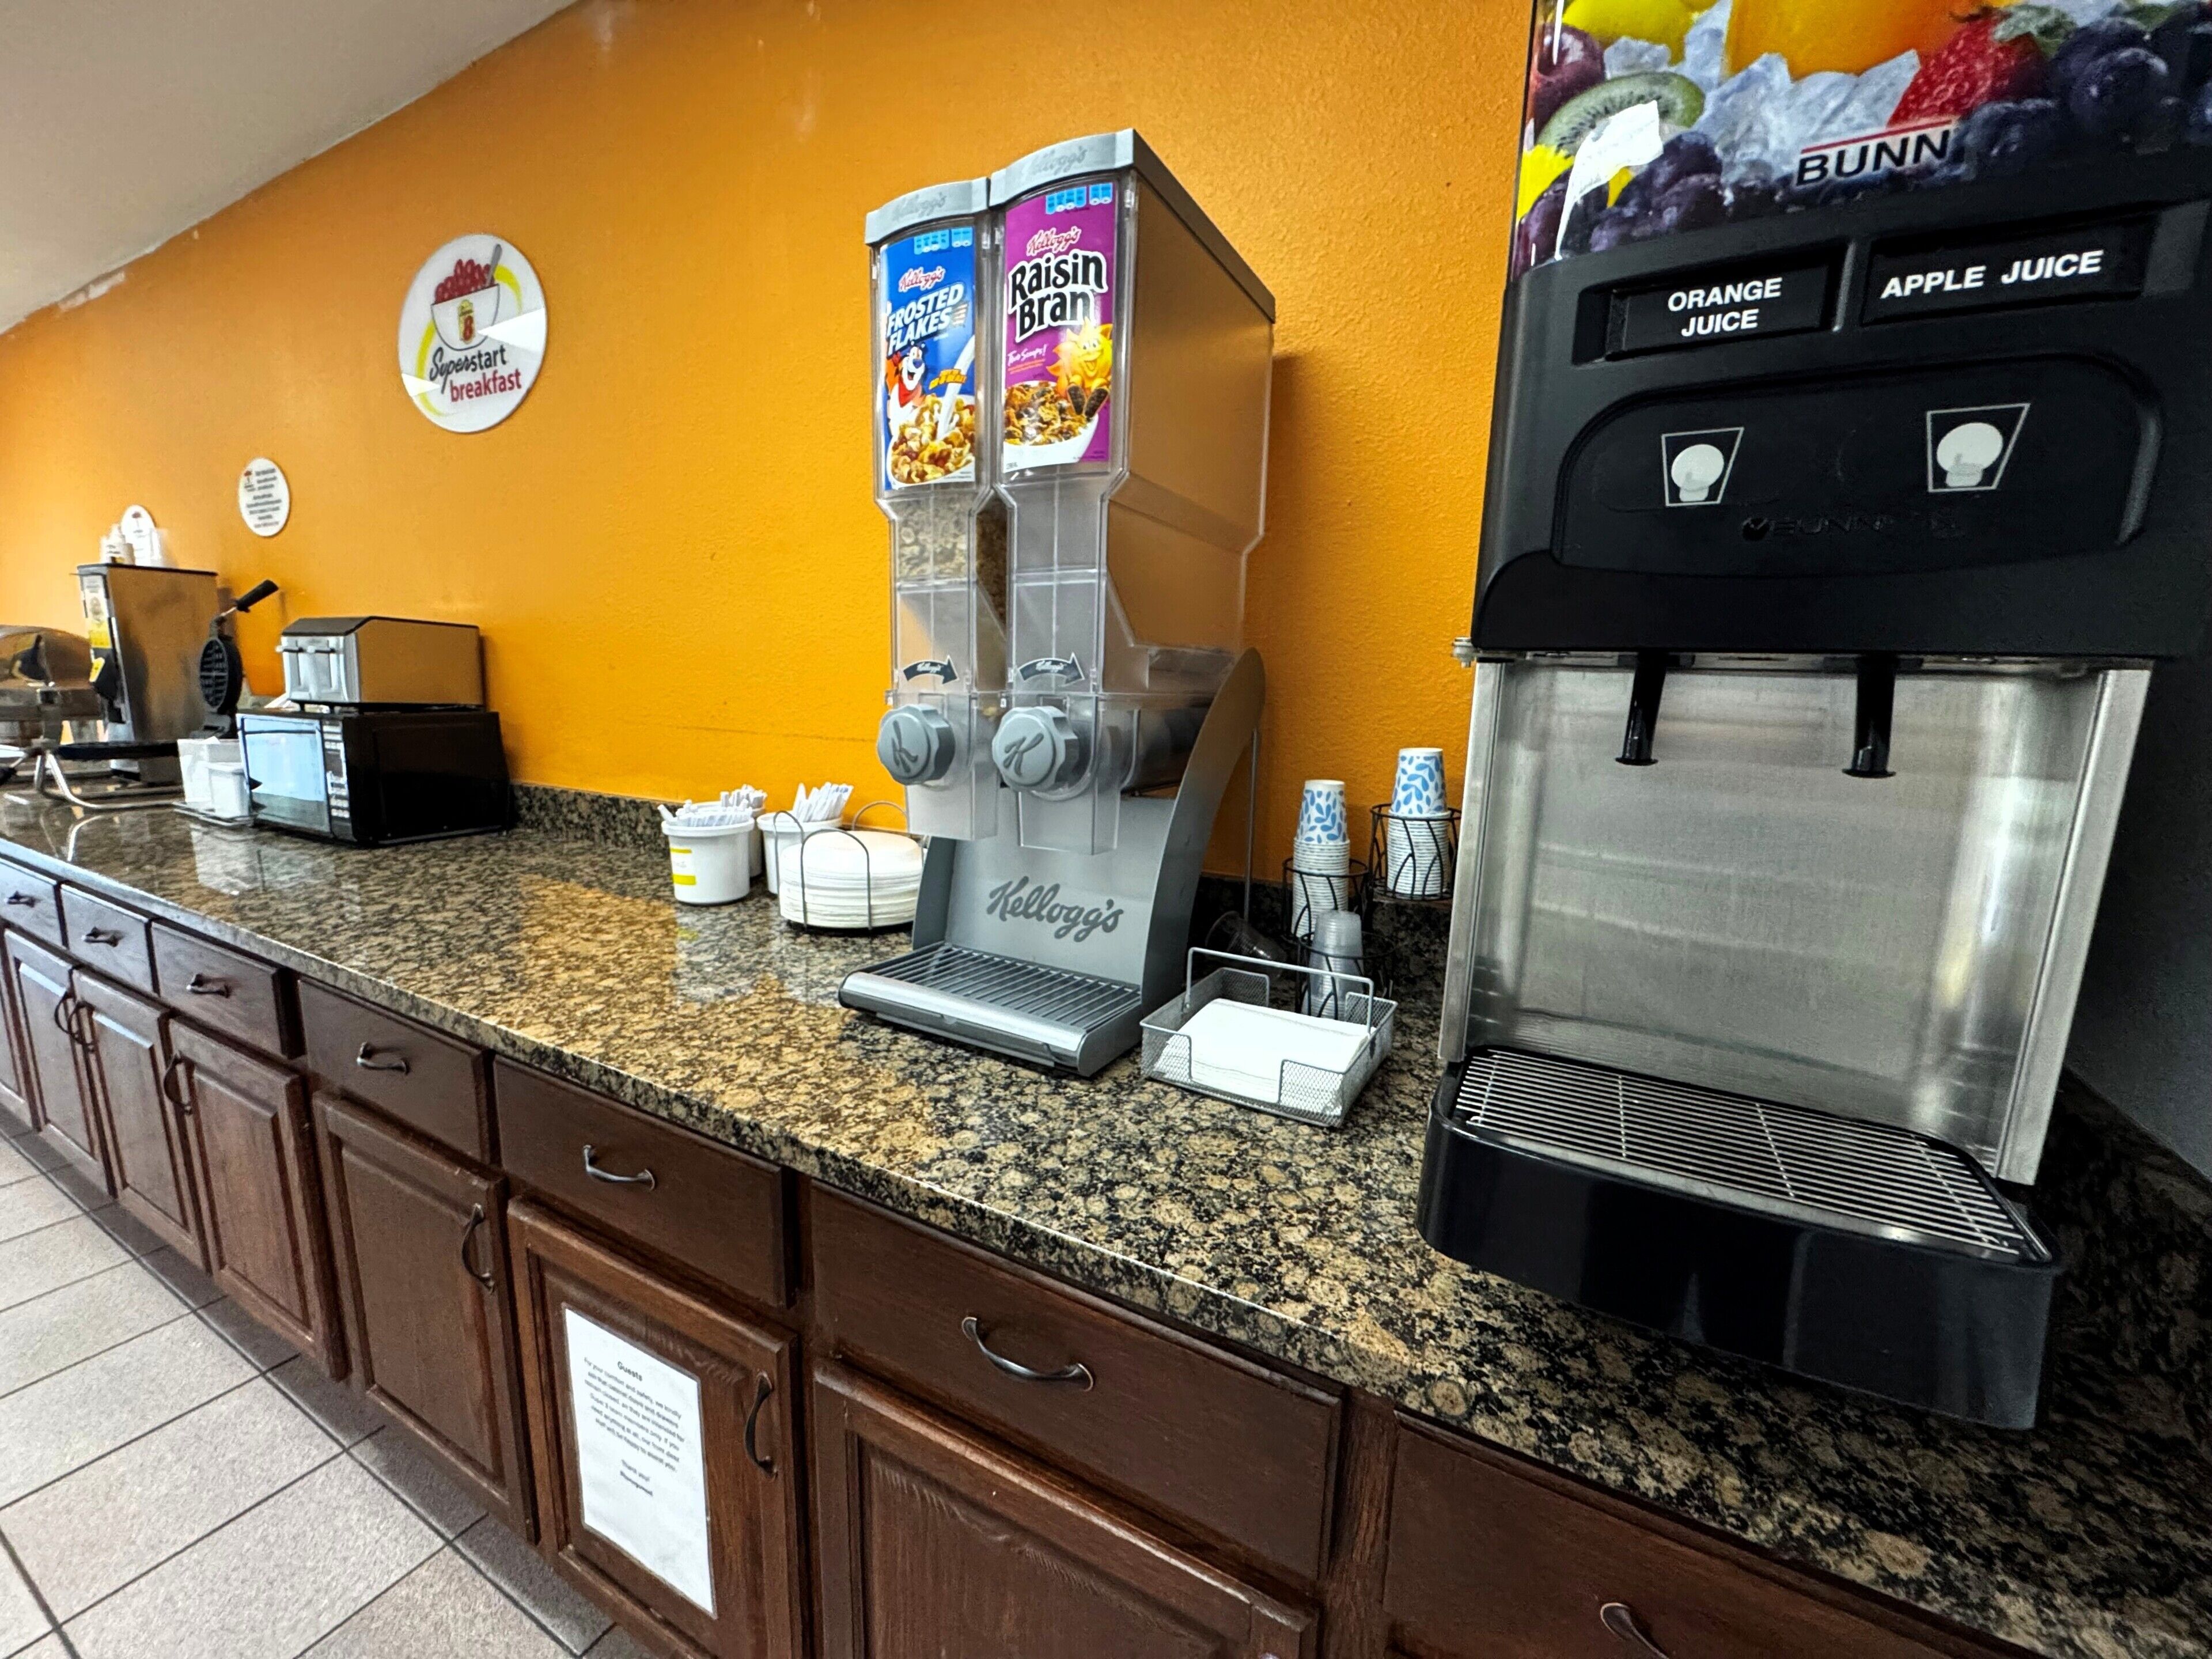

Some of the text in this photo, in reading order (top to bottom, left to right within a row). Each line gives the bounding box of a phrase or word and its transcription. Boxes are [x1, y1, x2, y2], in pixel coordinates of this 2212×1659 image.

[1797, 129, 1950, 185] BUNN
[1027, 227, 1081, 255] Kellogg's
[899, 267, 945, 291] Kellogg's
[1010, 252, 1105, 310] Raisin
[1668, 277, 1783, 312] ORANGE
[1880, 249, 2105, 300] APPLE JUICE
[887, 283, 964, 338] FROSTED
[888, 307, 952, 357] FLAKES
[1019, 290, 1091, 338] Bran
[1680, 308, 1759, 337] JUICE
[429, 344, 507, 395] Superstart
[450, 368, 522, 402] breakfast
[987, 876, 1124, 942] Kellogg's
[617, 1361, 642, 1381] Guests
